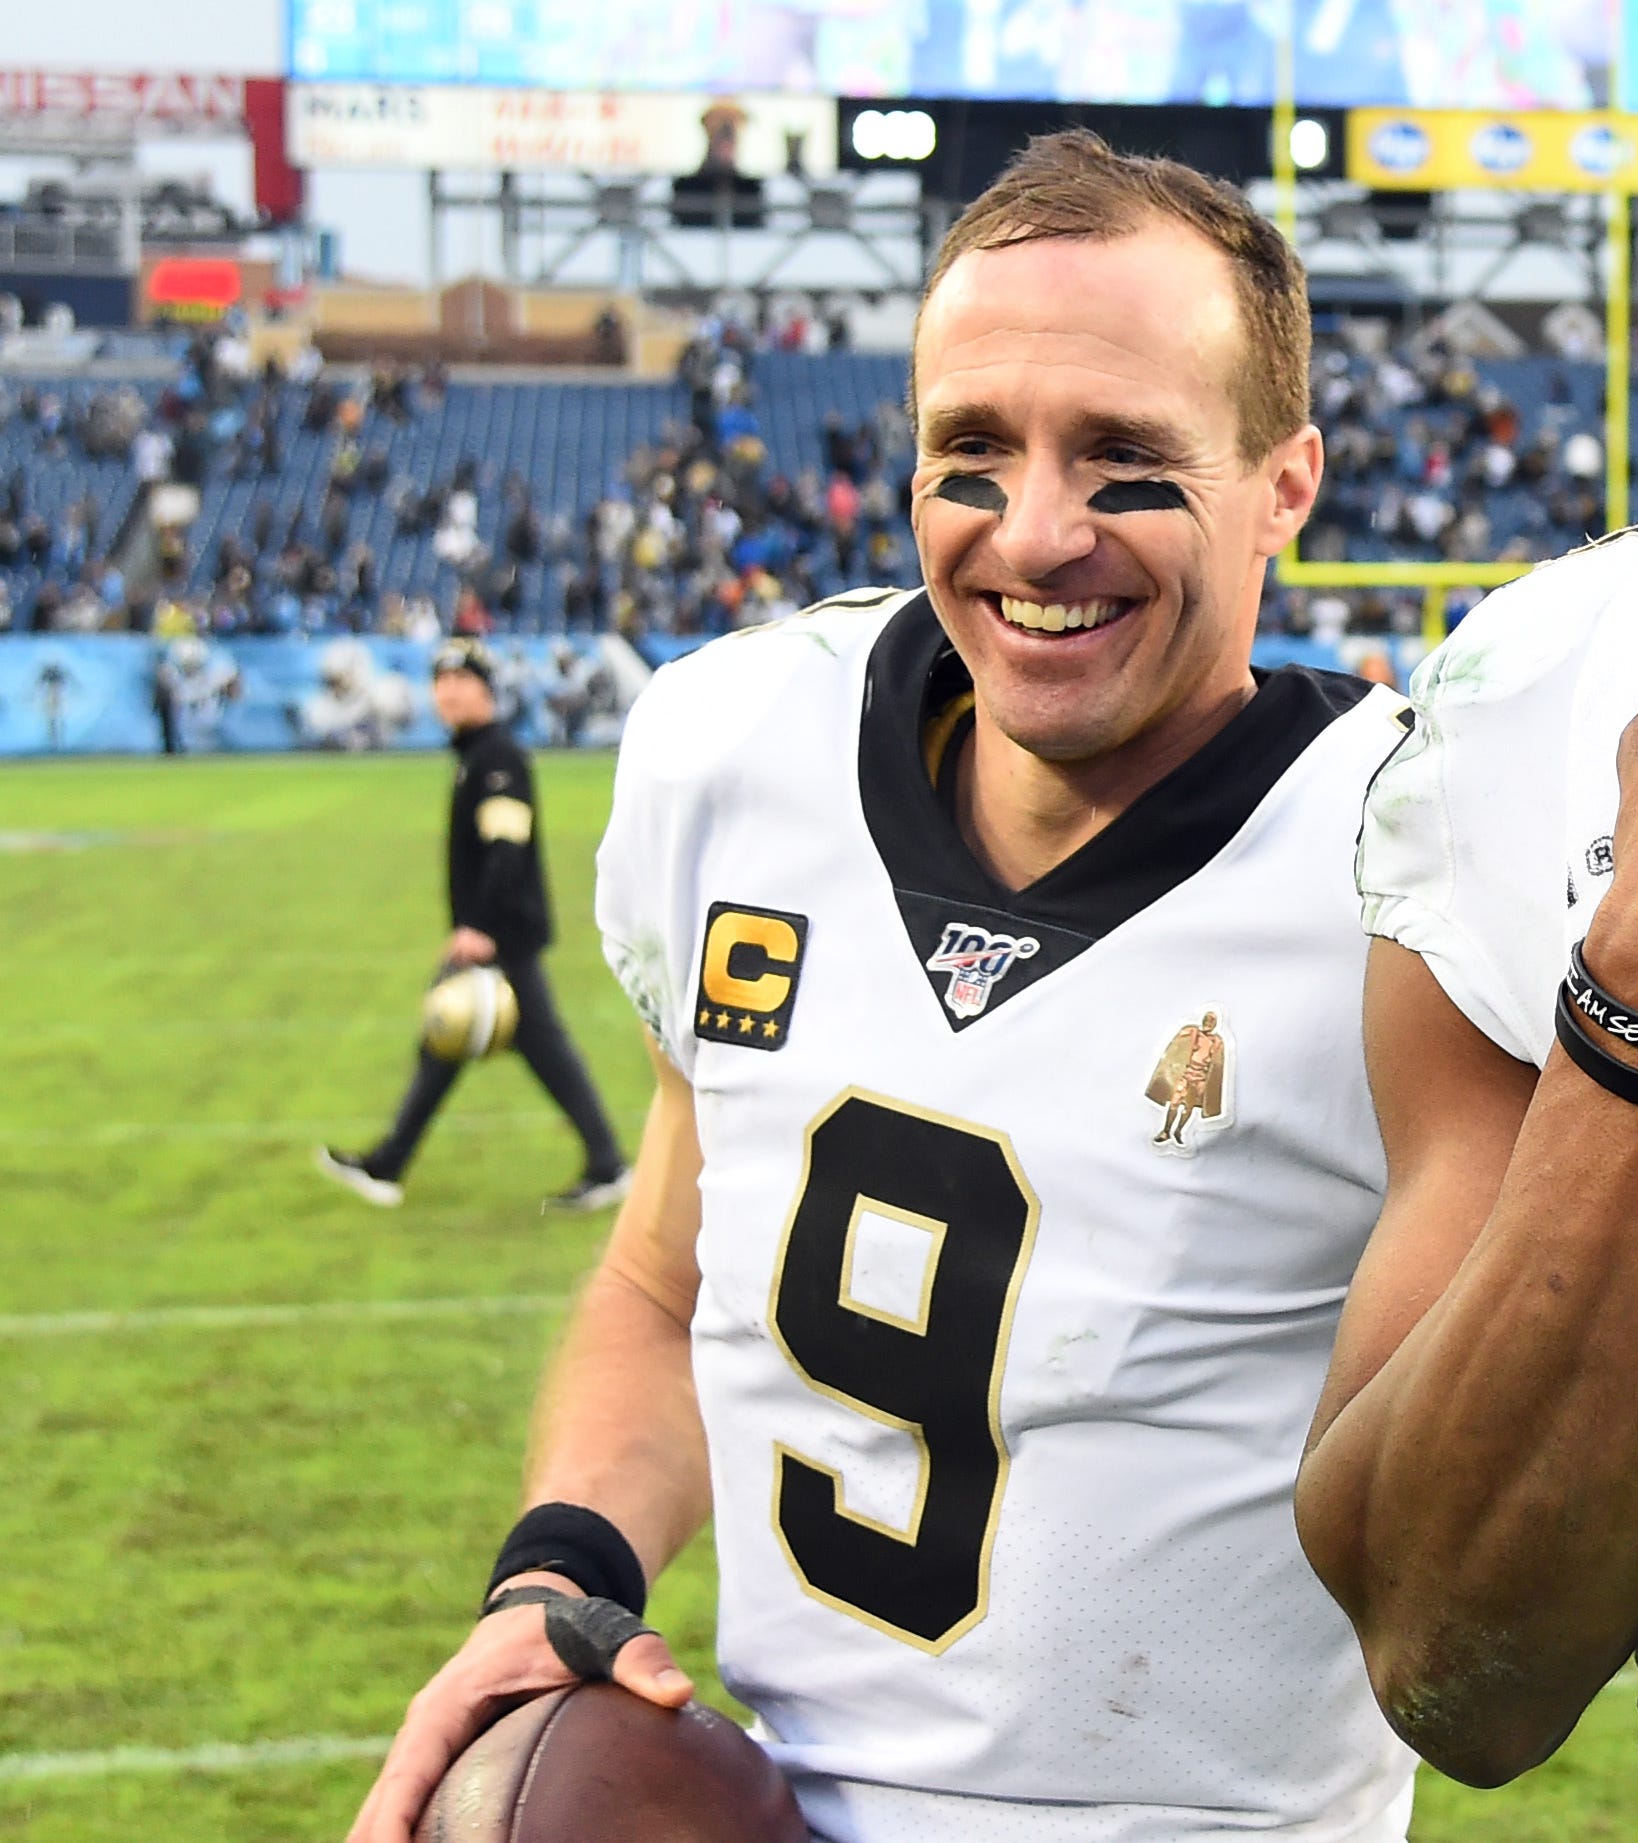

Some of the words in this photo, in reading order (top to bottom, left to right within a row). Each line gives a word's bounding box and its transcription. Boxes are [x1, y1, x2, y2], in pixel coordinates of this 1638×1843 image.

[703, 911, 799, 1013] C
[1577, 989, 1608, 1024] AM
[766, 1084, 1042, 1657] 9
